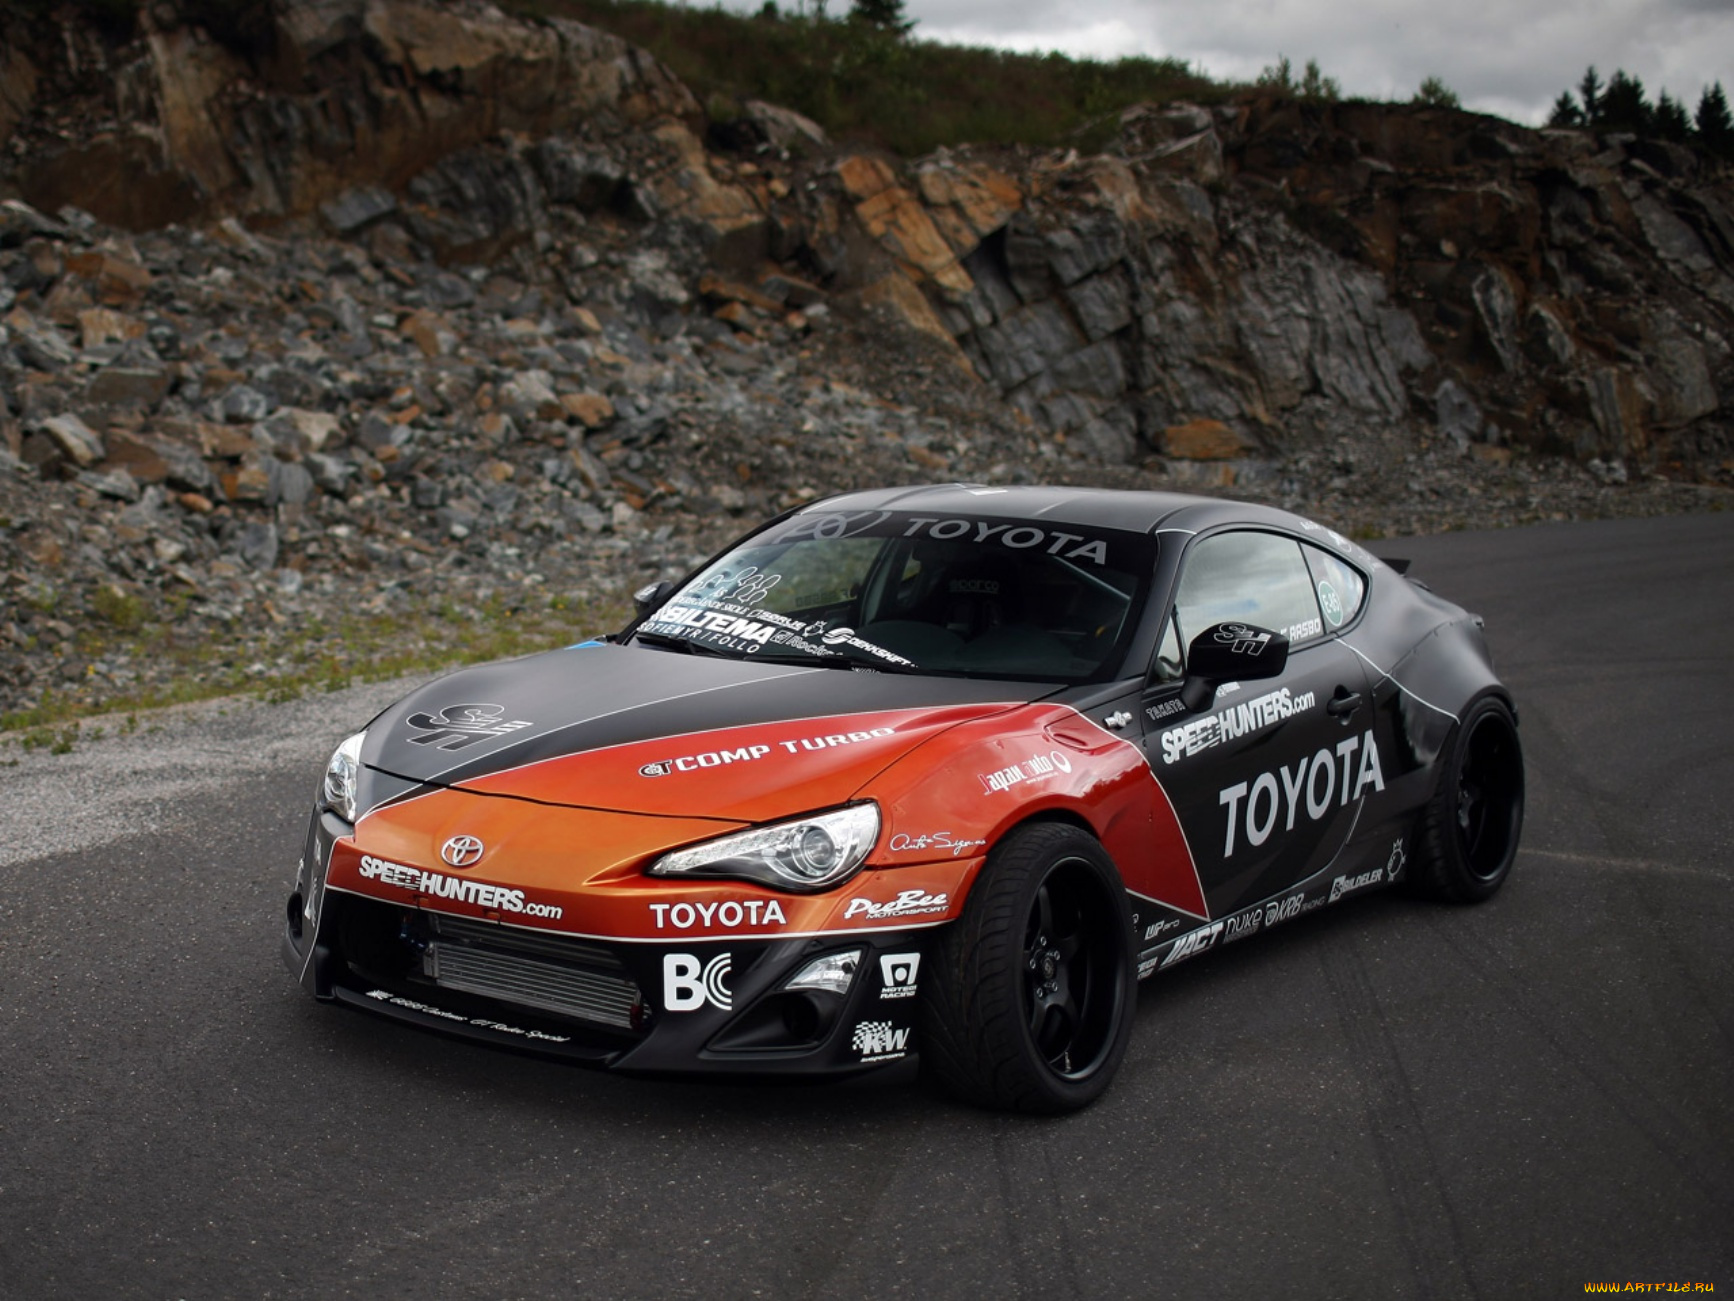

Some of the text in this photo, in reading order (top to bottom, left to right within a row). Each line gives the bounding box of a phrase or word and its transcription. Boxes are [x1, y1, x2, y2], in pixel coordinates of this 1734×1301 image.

[902, 517, 1107, 565] TOYOTA
[660, 605, 777, 645] BILTEMA
[674, 744, 771, 772] COMP
[778, 727, 896, 754] TURBO
[1219, 729, 1386, 858] TOYOTA
[649, 900, 787, 928] TOYOTA
[865, 905, 949, 919] MOTORSPORT
